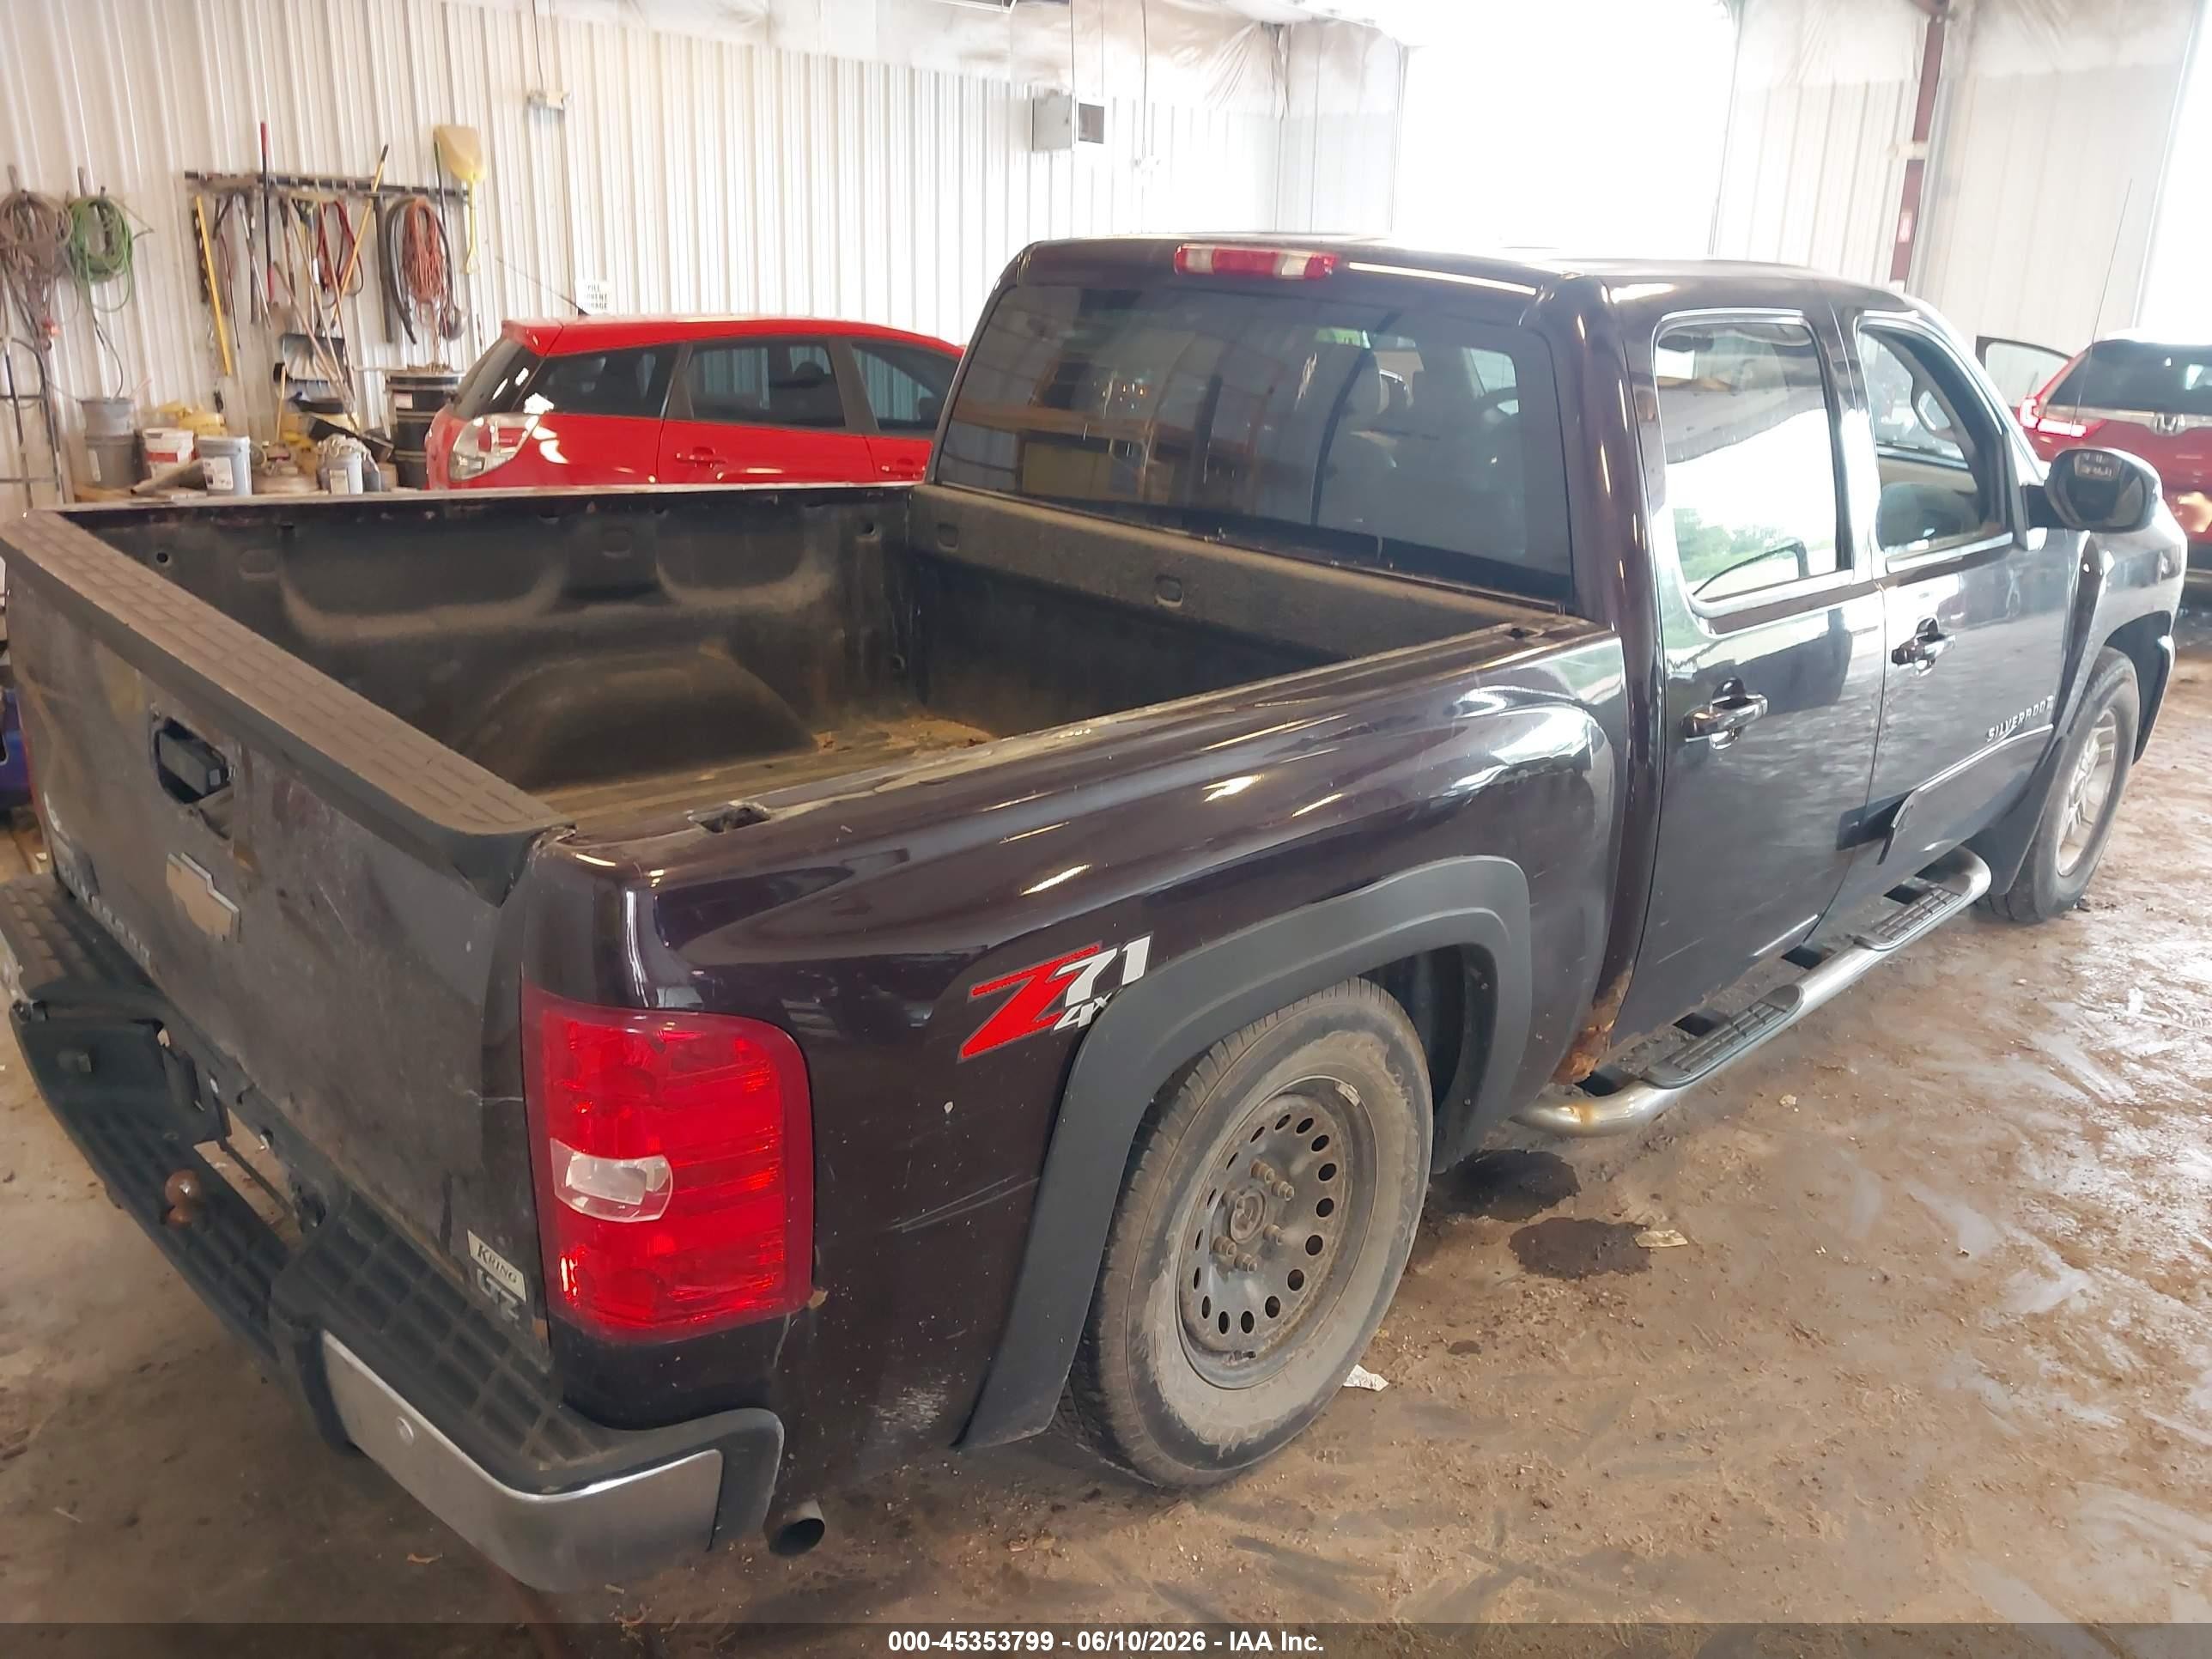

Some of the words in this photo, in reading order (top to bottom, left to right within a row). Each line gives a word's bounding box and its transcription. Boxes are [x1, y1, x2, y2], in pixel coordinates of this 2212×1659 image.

[957, 933, 1152, 1060] Z71
[477, 1243, 517, 1284] KRING
[476, 1267, 520, 1322] LTZ
